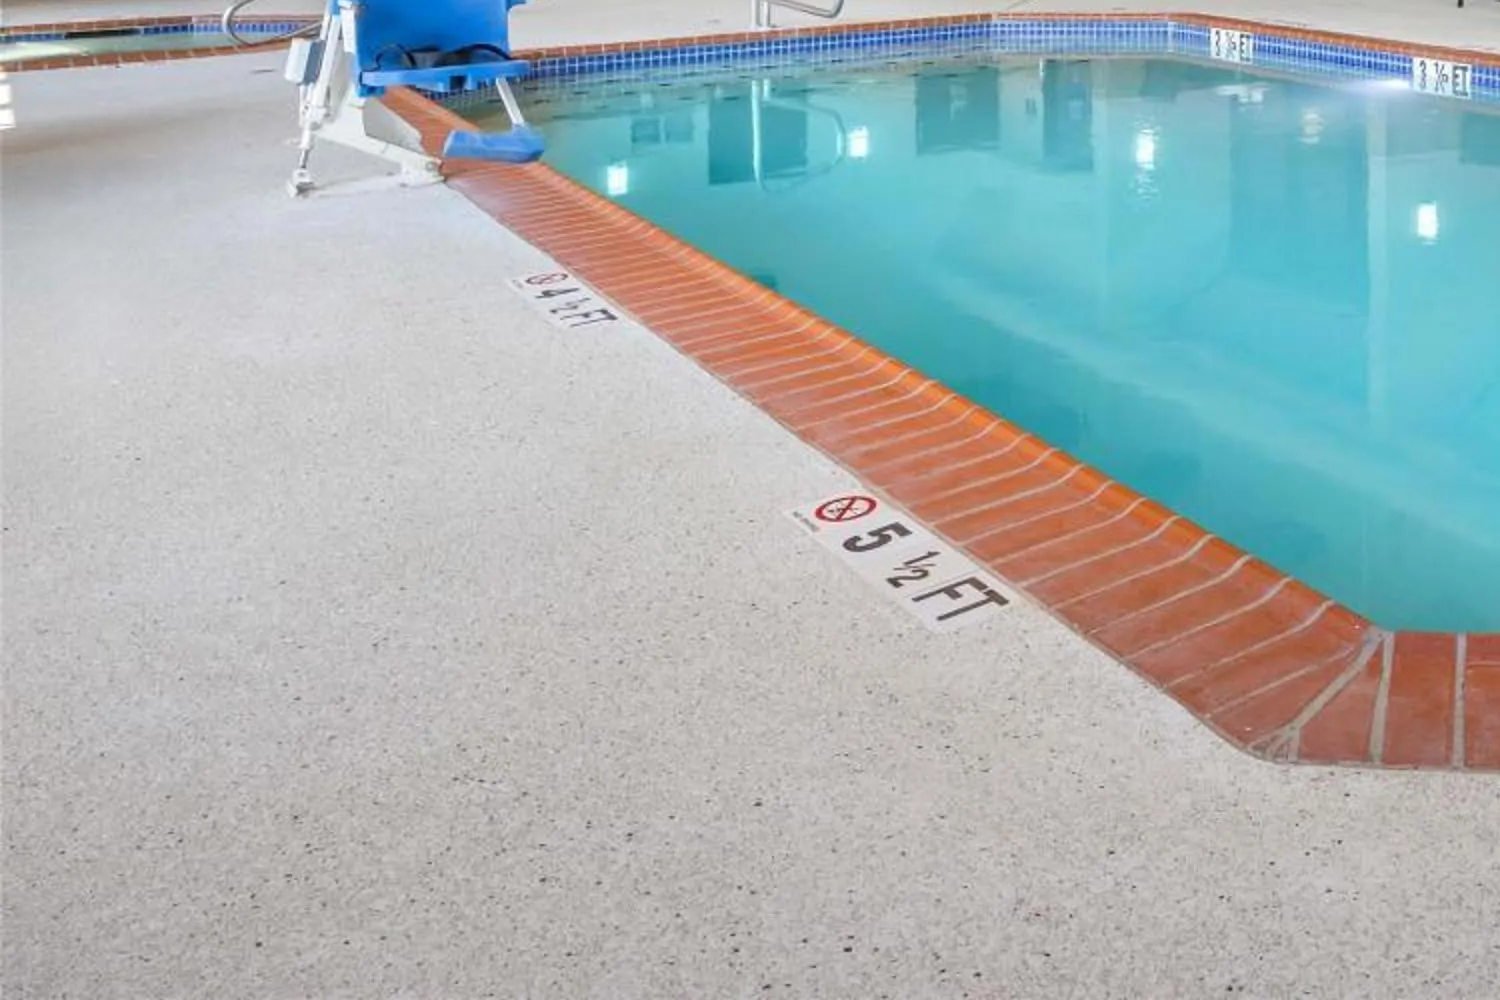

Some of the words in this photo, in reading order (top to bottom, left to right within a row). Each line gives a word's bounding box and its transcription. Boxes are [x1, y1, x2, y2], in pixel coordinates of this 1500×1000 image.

[535, 287, 580, 299] 4
[559, 307, 618, 328] FT
[842, 521, 913, 553] 5
[911, 576, 1010, 622] FT
